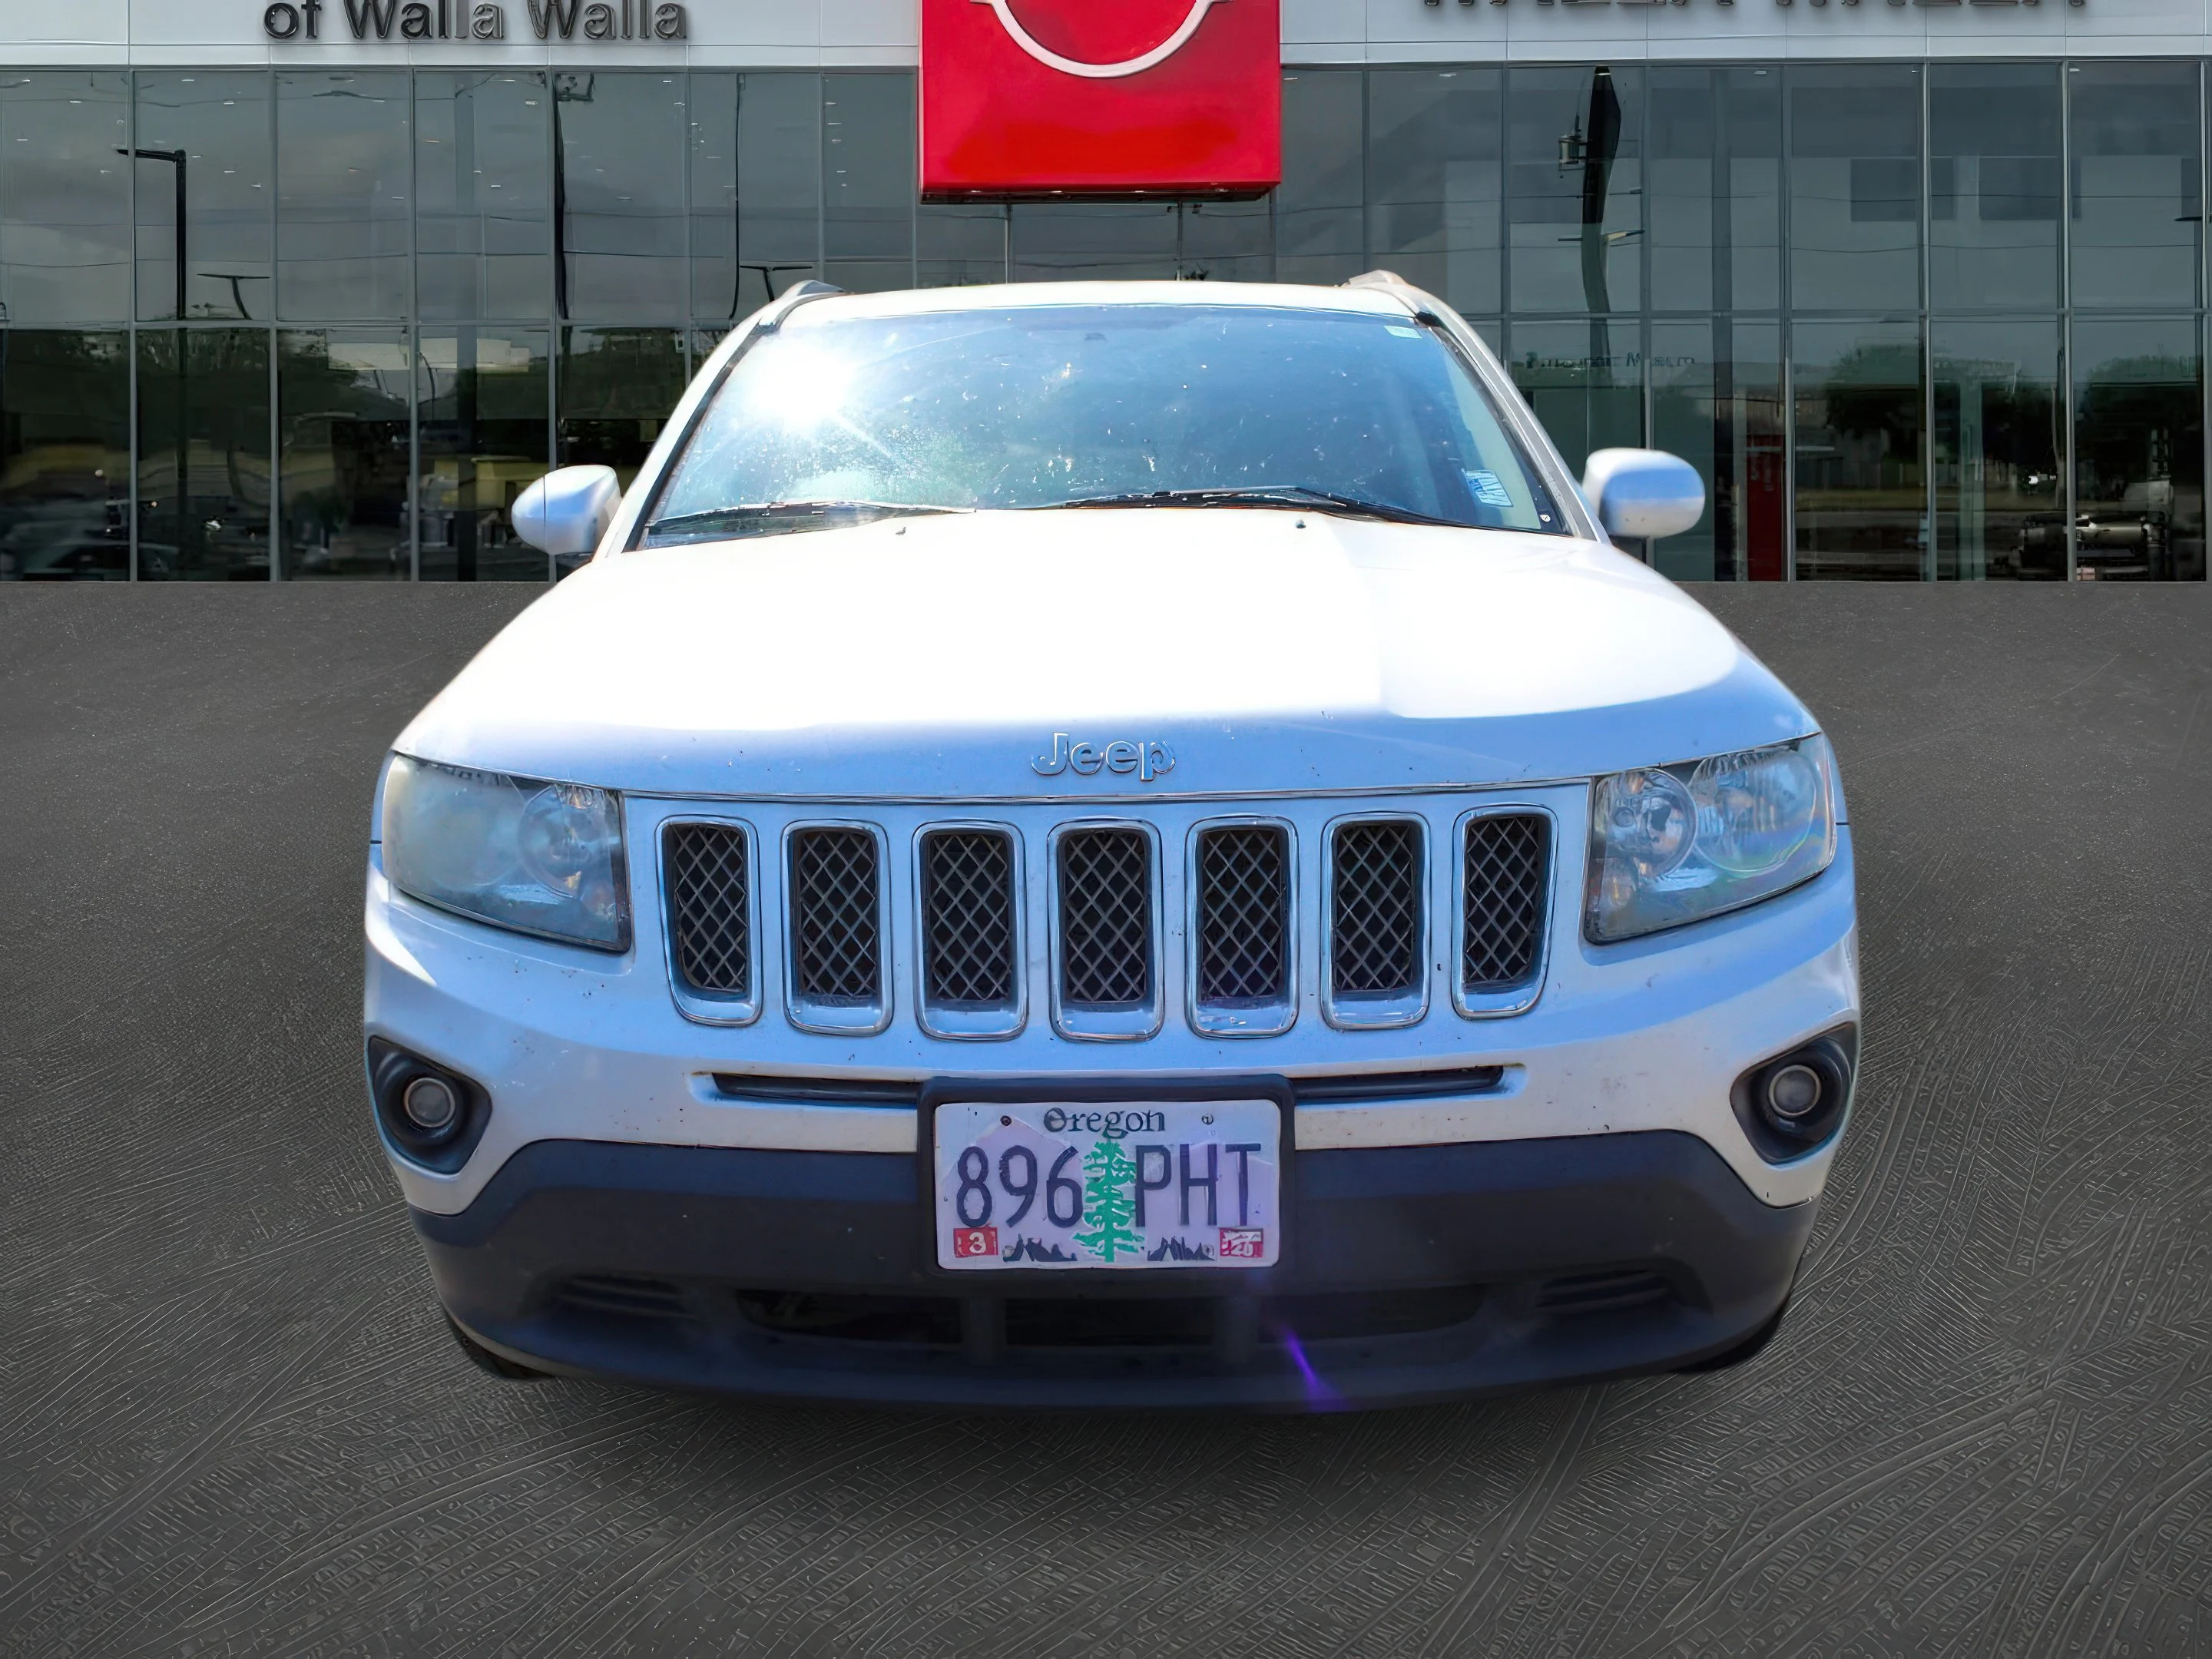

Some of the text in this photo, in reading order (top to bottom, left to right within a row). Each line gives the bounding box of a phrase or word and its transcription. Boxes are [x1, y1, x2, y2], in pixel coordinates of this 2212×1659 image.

[263, 0, 687, 39] of Walla Walla
[1031, 731, 1177, 782] Jeep
[1043, 1107, 1165, 1139] Oregon
[956, 1143, 1262, 1228] 896 PHT
